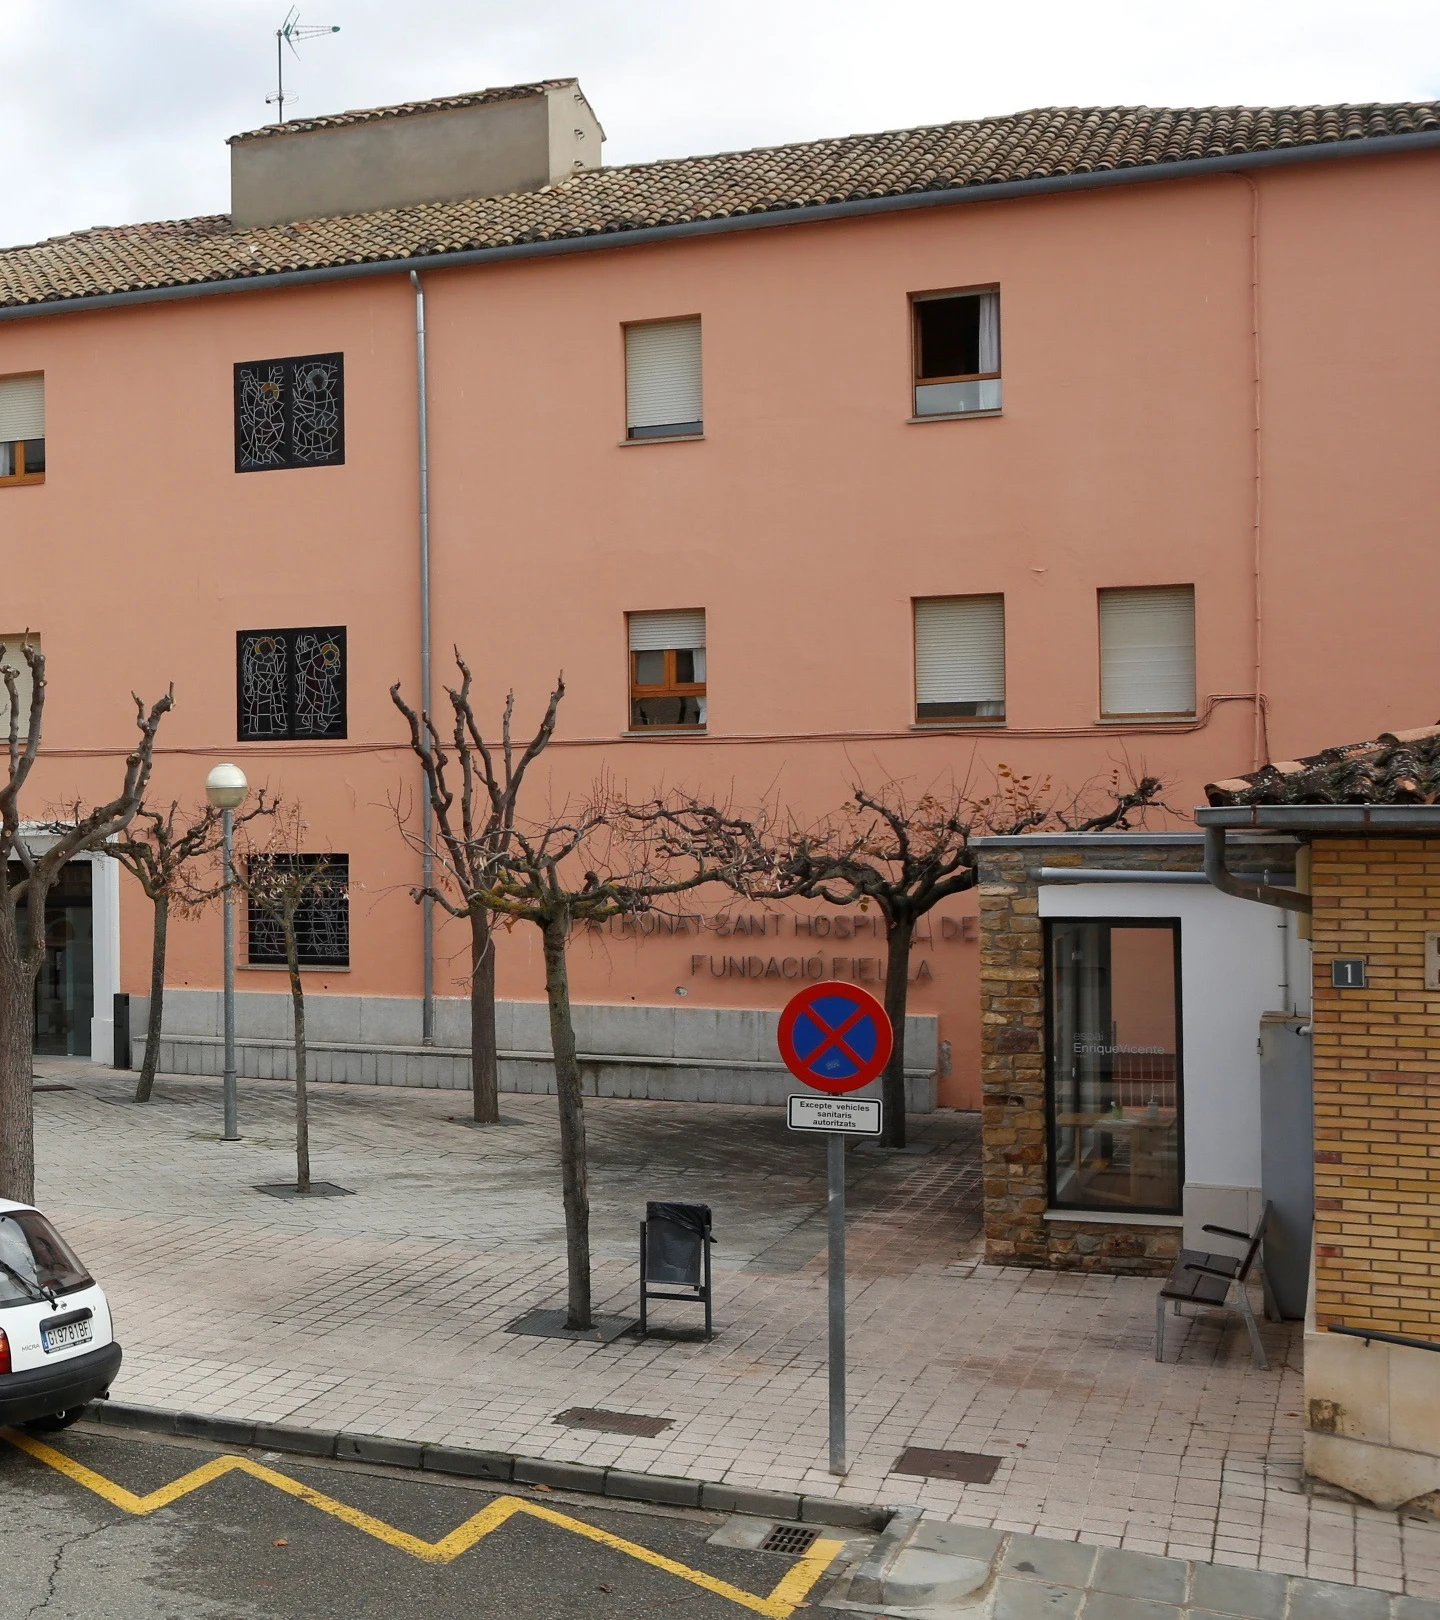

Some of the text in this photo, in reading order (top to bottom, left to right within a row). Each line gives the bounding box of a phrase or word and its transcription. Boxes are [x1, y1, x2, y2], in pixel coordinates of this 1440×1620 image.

[715, 914, 785, 936] SANT
[795, 914, 932, 941] HOSPIL
[691, 950, 933, 982] FUNDACIÓ FIELA
[1344, 963, 1352, 984] 1
[1073, 1031, 1104, 1043] espai
[1073, 1043, 1165, 1055] EnriqueVicente
[800, 1101, 870, 1112] Excepte vehicles
[817, 1111, 852, 1119] sanitaris
[813, 1119, 856, 1128] autoritzats
[21, 1343, 40, 1352] MICRA
